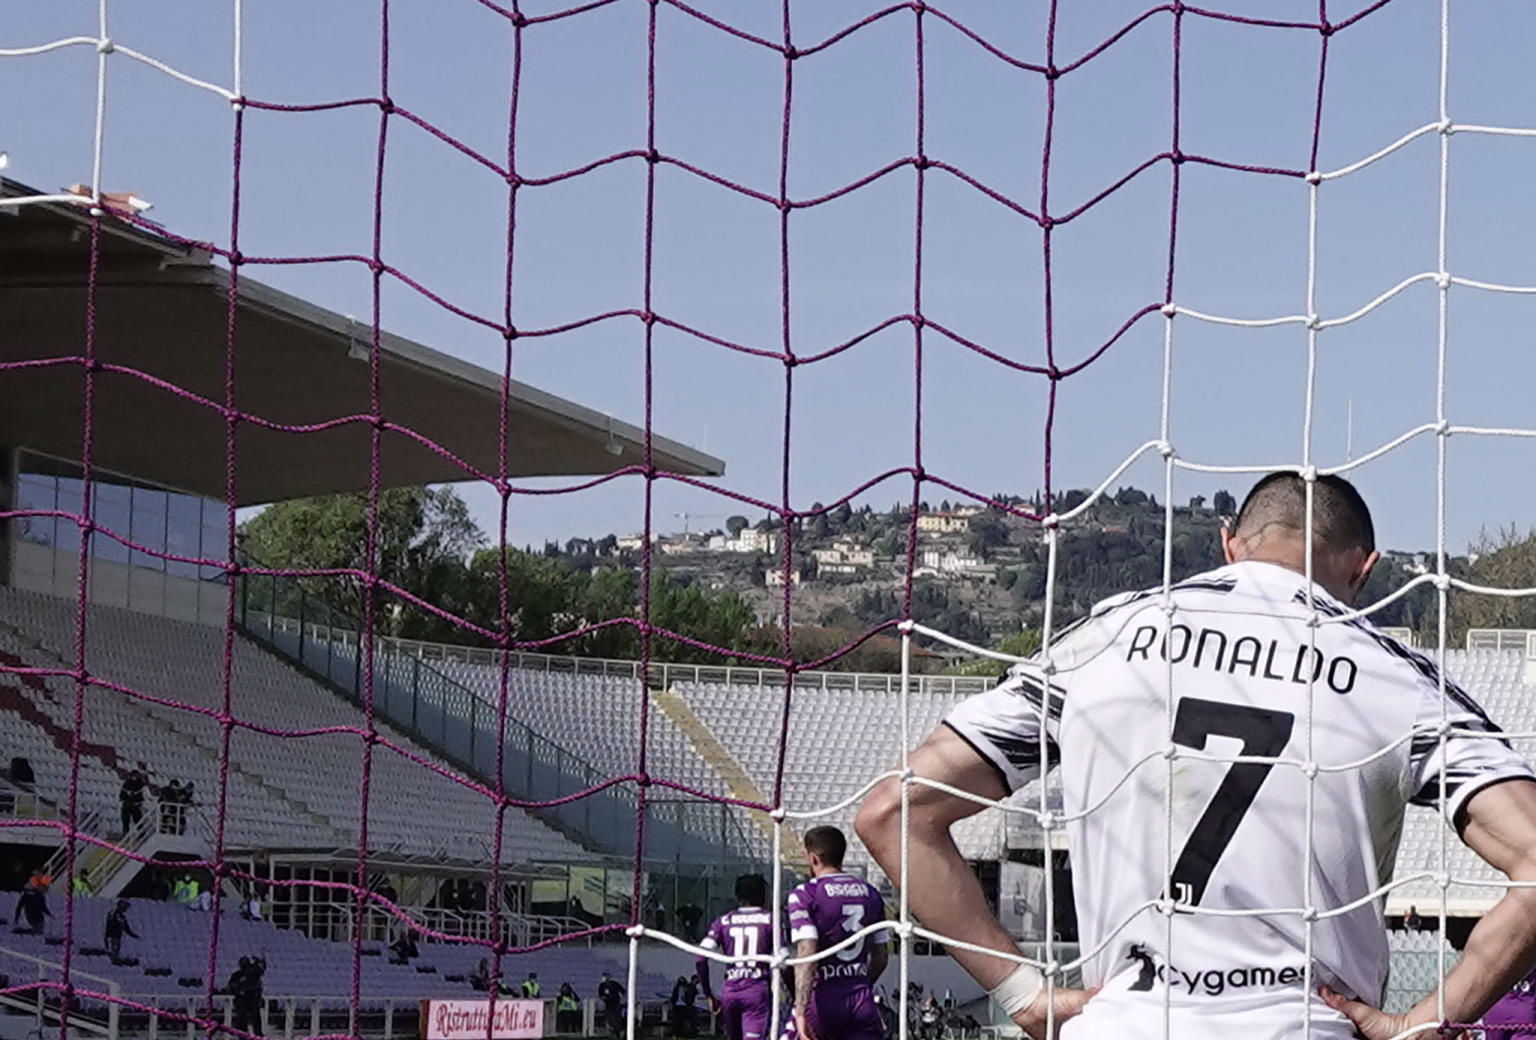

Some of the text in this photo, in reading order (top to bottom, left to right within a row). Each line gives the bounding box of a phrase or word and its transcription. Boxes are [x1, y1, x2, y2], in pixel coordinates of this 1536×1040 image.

[1126, 623, 1358, 695] RONALDO
[1155, 695, 1295, 914] 7
[729, 926, 759, 968] 11
[836, 904, 865, 962] 3
